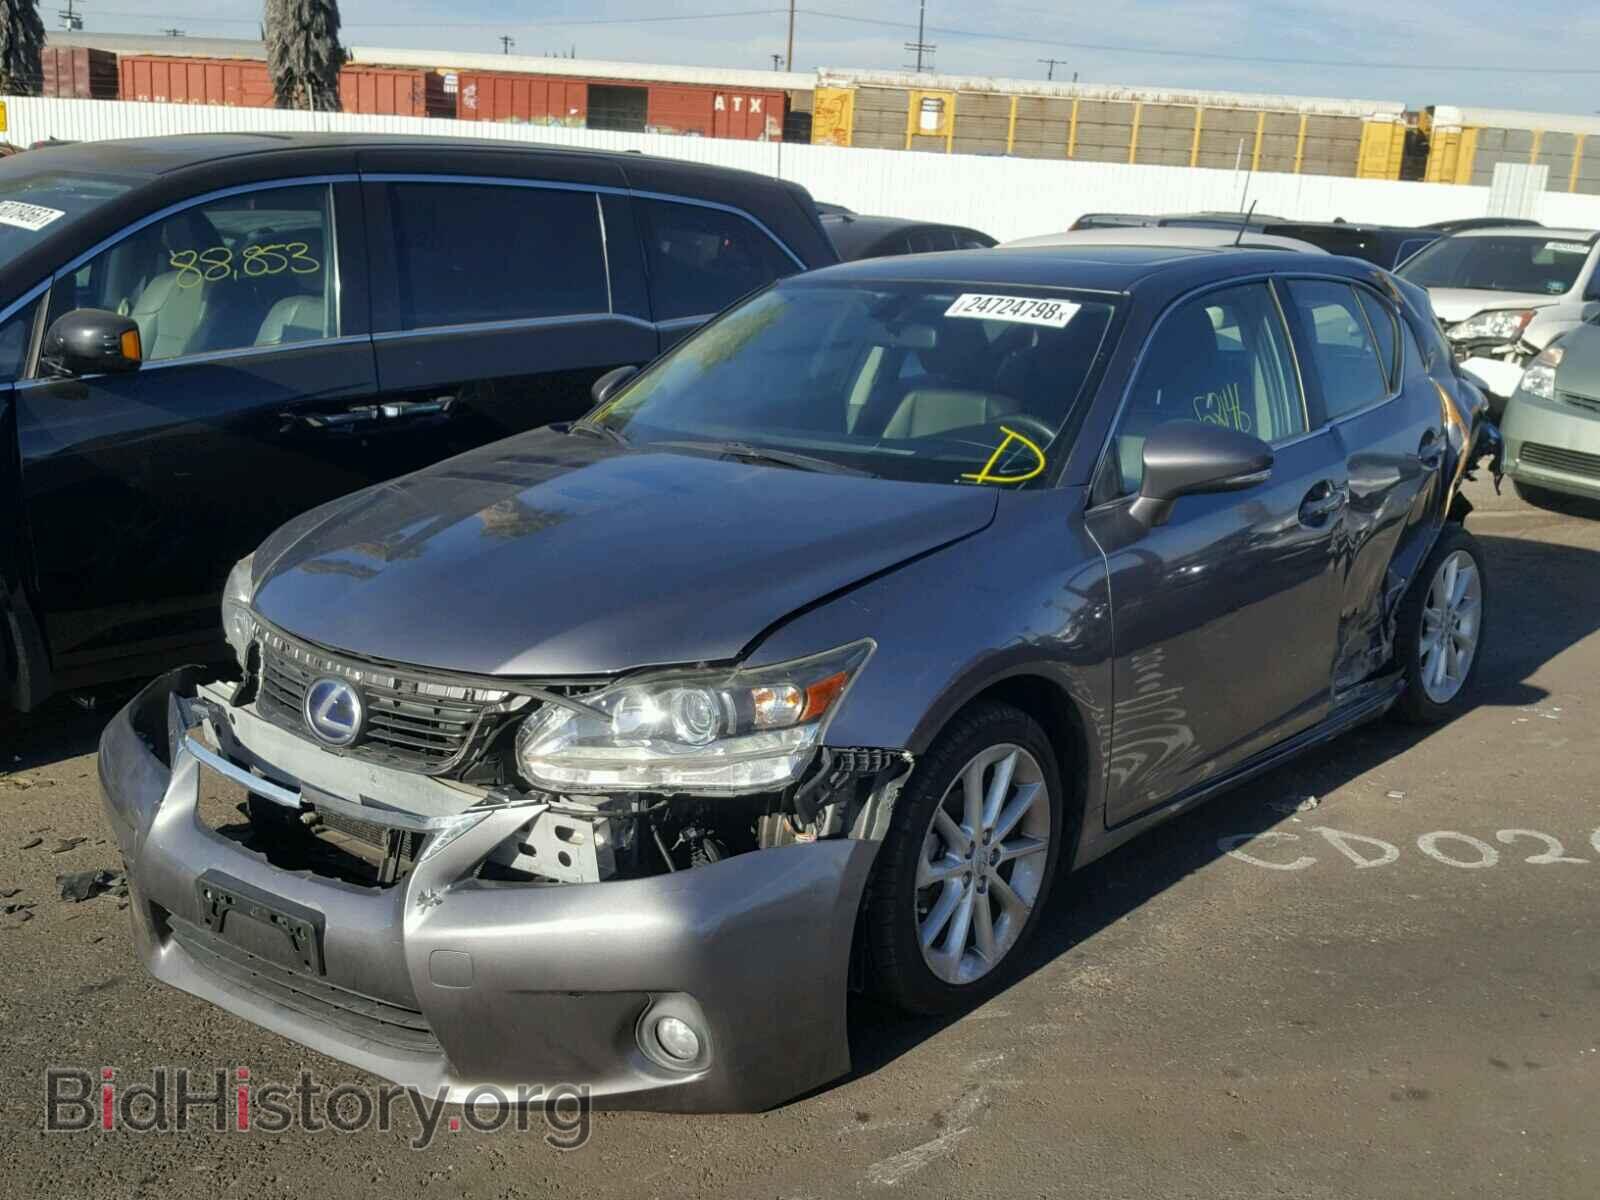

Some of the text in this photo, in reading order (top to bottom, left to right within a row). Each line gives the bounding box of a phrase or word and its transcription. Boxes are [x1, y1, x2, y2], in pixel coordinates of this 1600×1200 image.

[714, 95, 762, 113] ATX
[169, 242, 321, 288] 88,853
[960, 425, 1046, 485] D
